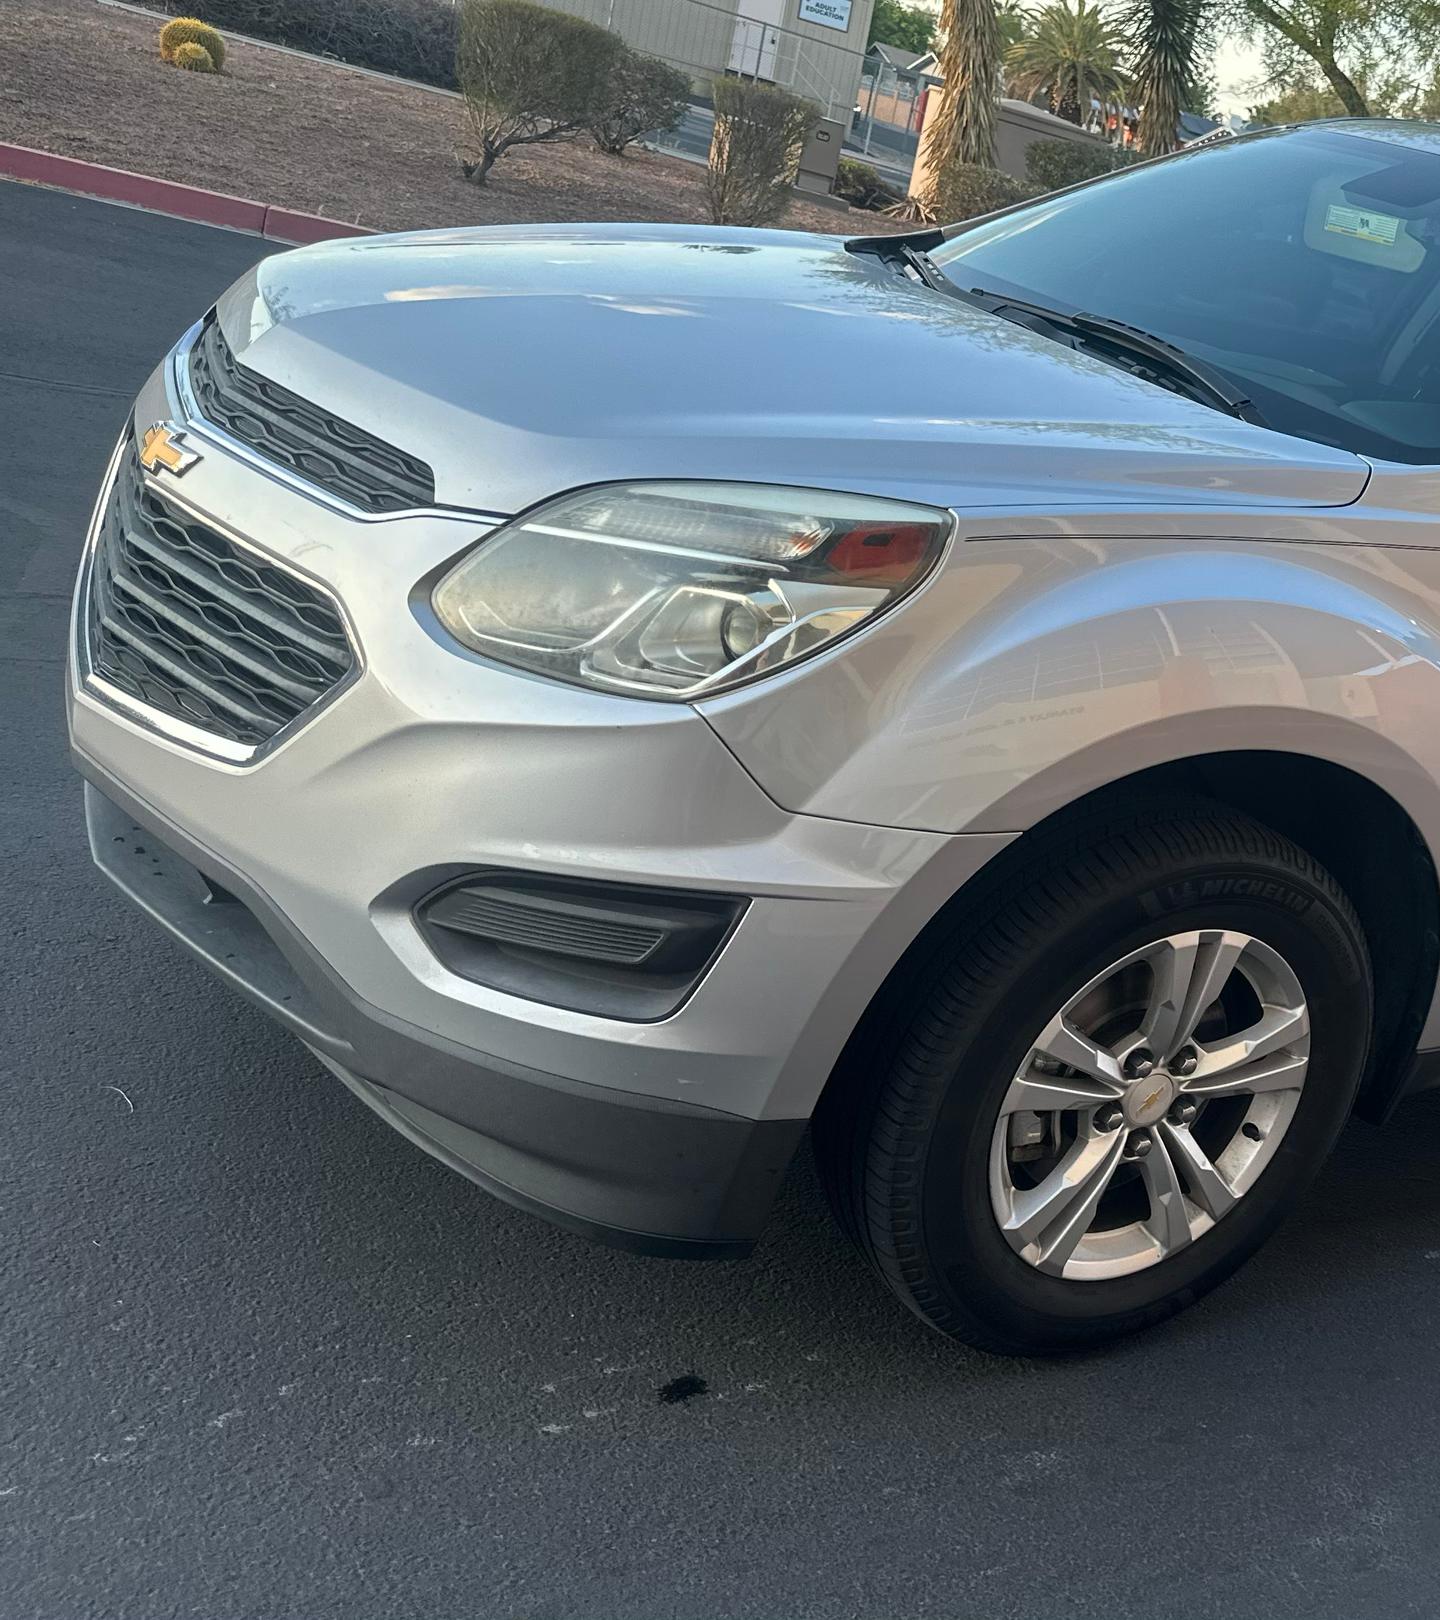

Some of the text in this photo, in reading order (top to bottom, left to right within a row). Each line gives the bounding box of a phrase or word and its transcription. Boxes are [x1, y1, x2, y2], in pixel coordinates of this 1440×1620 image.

[805, 5, 844, 21] EDUCATION
[815, 2, 837, 13] ADULT
[1201, 878, 1310, 913] MICHELIN
